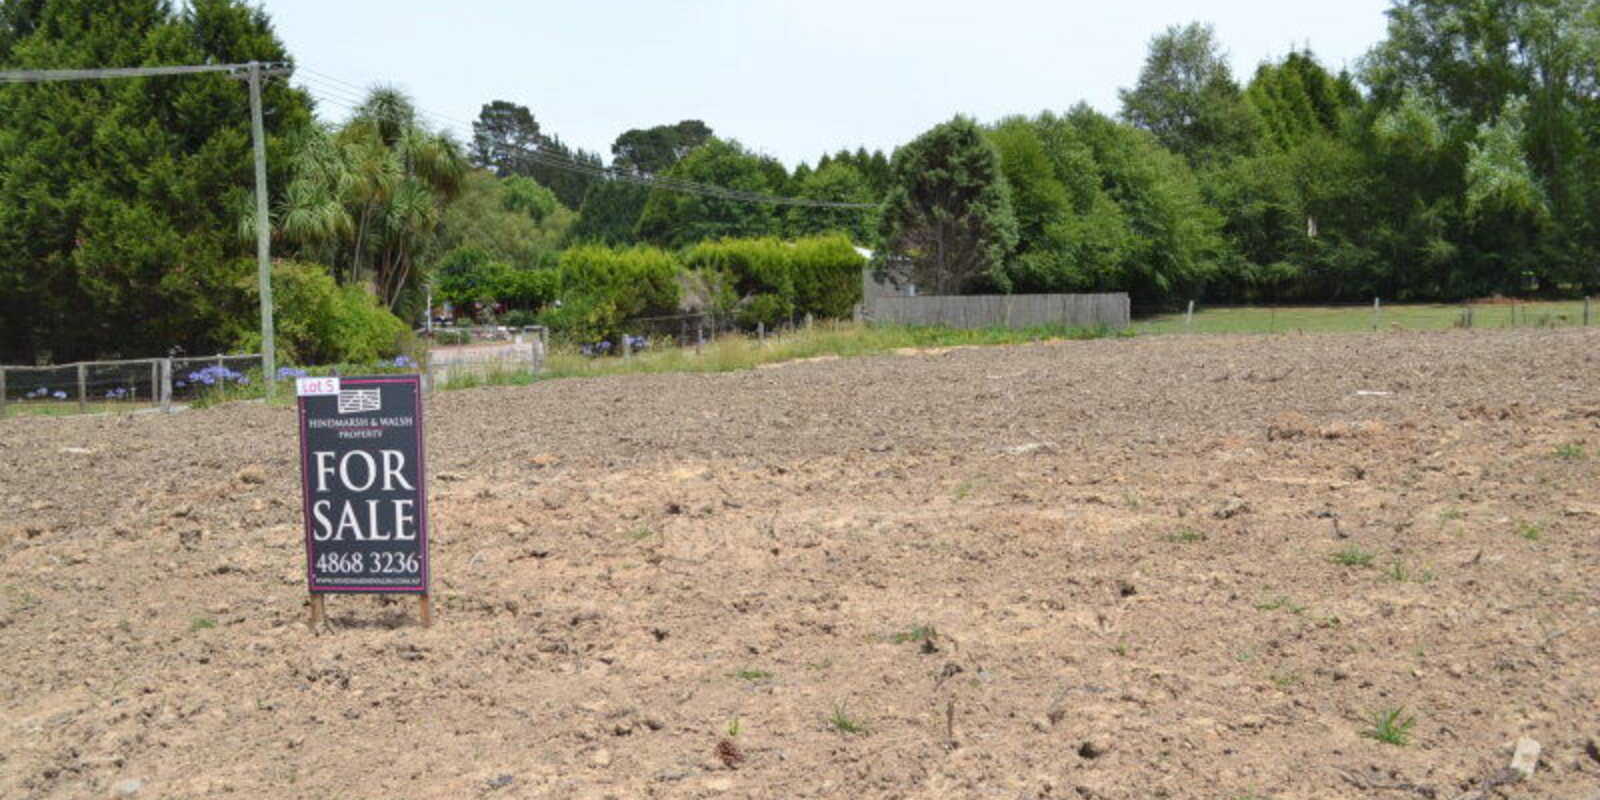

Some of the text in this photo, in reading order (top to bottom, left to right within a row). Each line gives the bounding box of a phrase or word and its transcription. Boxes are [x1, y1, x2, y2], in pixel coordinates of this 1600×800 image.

[308, 416, 413, 429] HINDMARSH & WALSH
[339, 430, 383, 439] PROPERTY
[313, 449, 415, 492] FOR
[313, 499, 416, 541] SALE
[316, 551, 419, 573] 4868 3236
